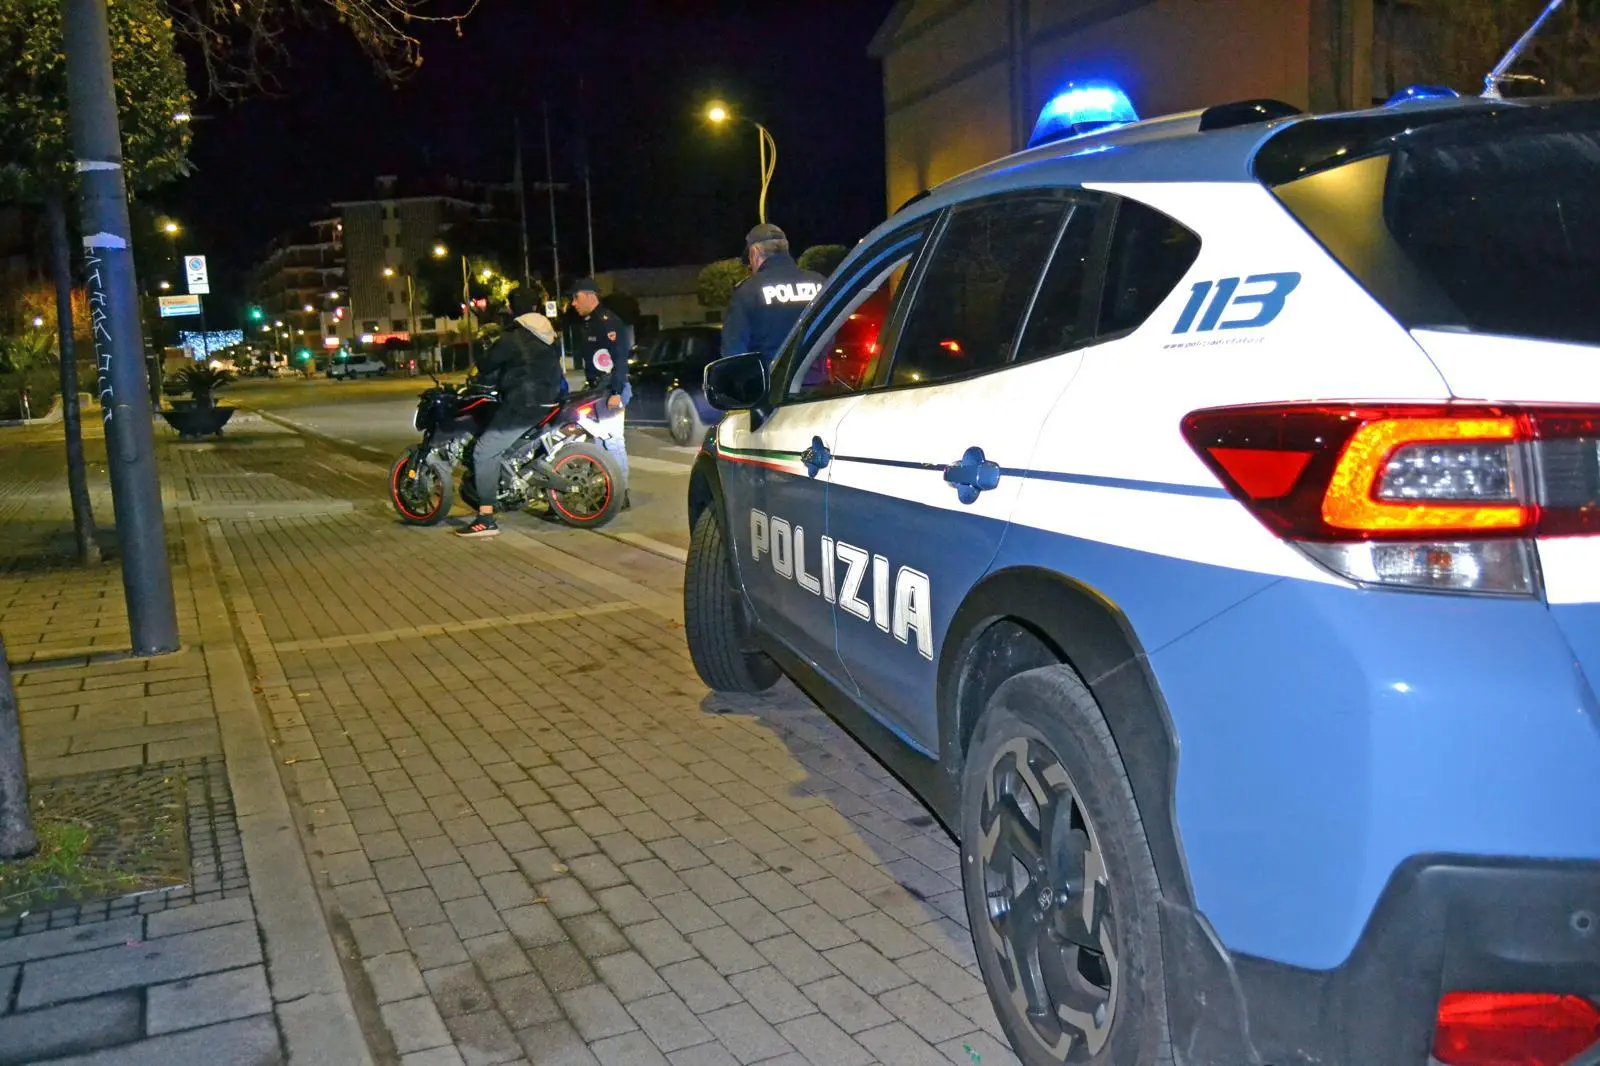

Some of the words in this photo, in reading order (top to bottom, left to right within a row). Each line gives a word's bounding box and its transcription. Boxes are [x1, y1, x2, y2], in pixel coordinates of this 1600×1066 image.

[762, 282, 823, 305] POLIZI
[1170, 271, 1302, 335] 113
[750, 507, 934, 662] POLIZIA
